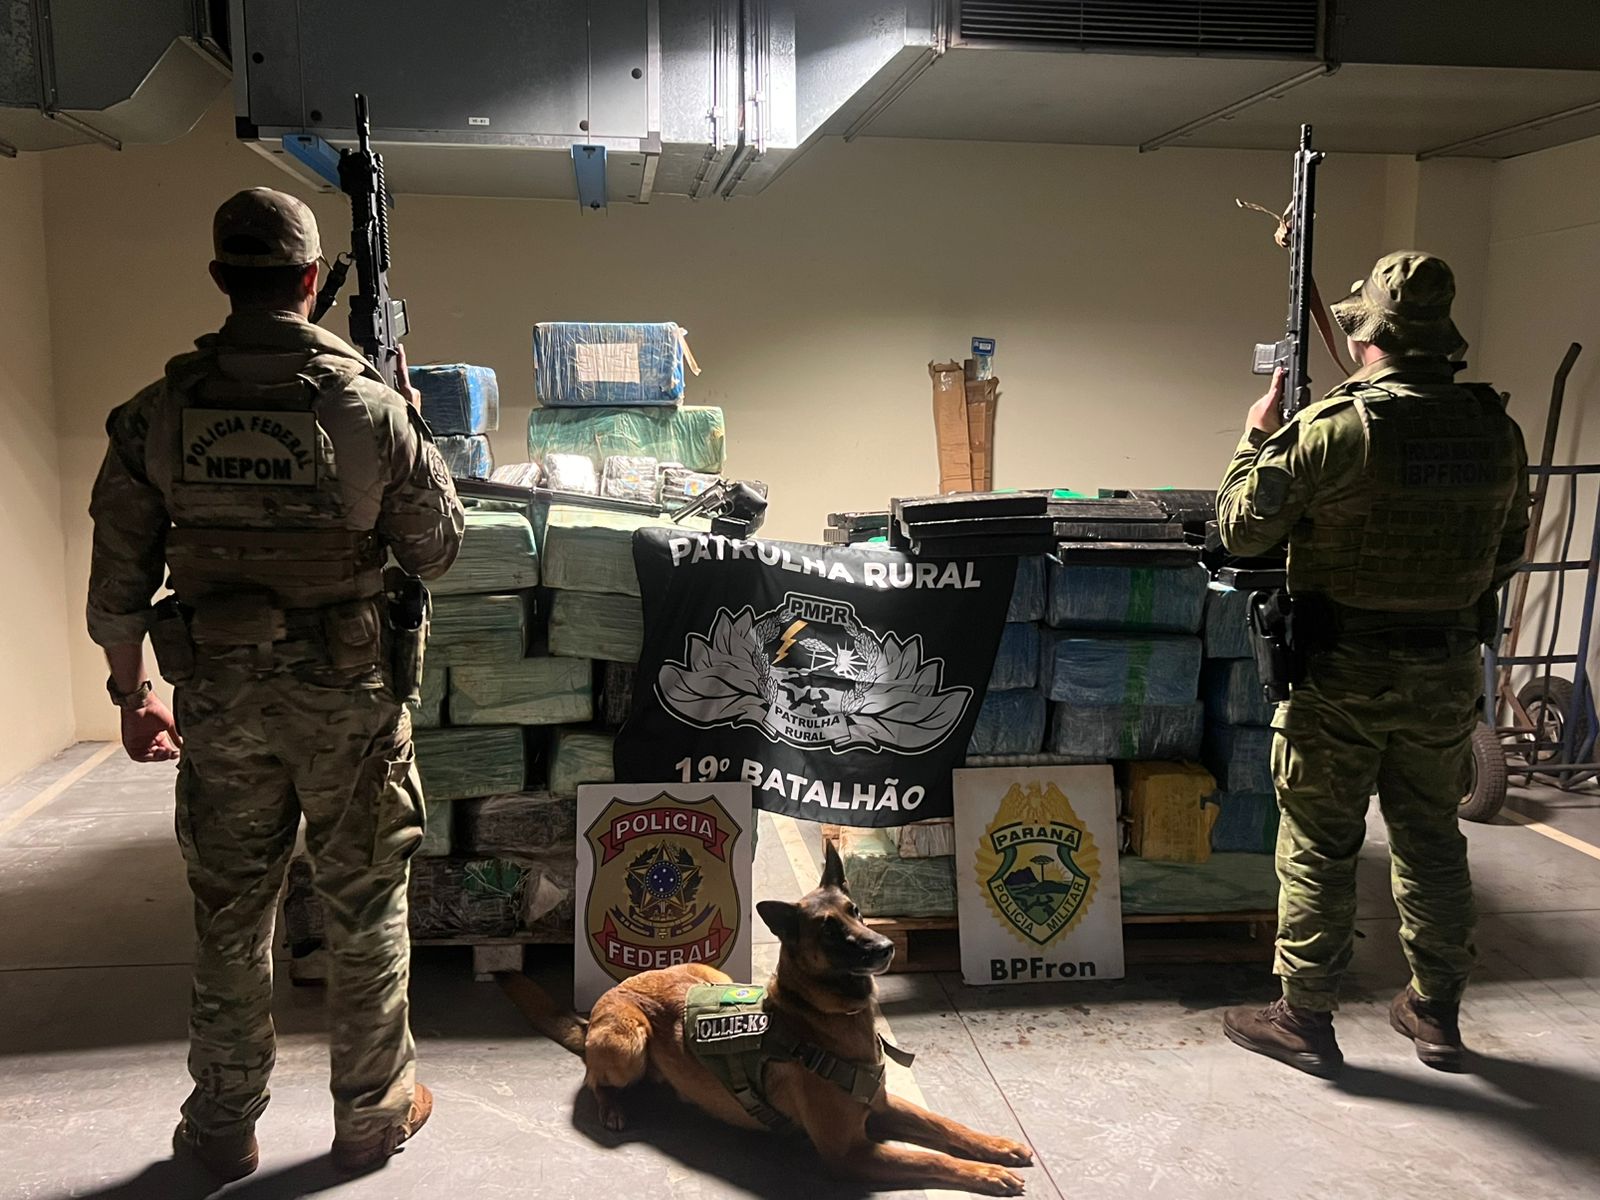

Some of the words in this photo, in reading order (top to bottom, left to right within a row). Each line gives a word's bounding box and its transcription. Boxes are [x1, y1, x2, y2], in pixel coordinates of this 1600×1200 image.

[250, 416, 313, 470] FEDERAL
[205, 456, 292, 480] NEPOM
[668, 534, 856, 584] PATRULHA
[863, 562, 981, 589] RURAL
[789, 597, 850, 625] PMPR
[774, 705, 841, 729] PATRULHA
[784, 726, 826, 741] RURAL
[740, 758, 926, 811] BATALHÃO
[996, 827, 1076, 846] PARANÁ
[1046, 882, 1084, 932] MILITAR
[608, 940, 717, 969] FEDERAL
[990, 957, 1096, 981] BPFron
